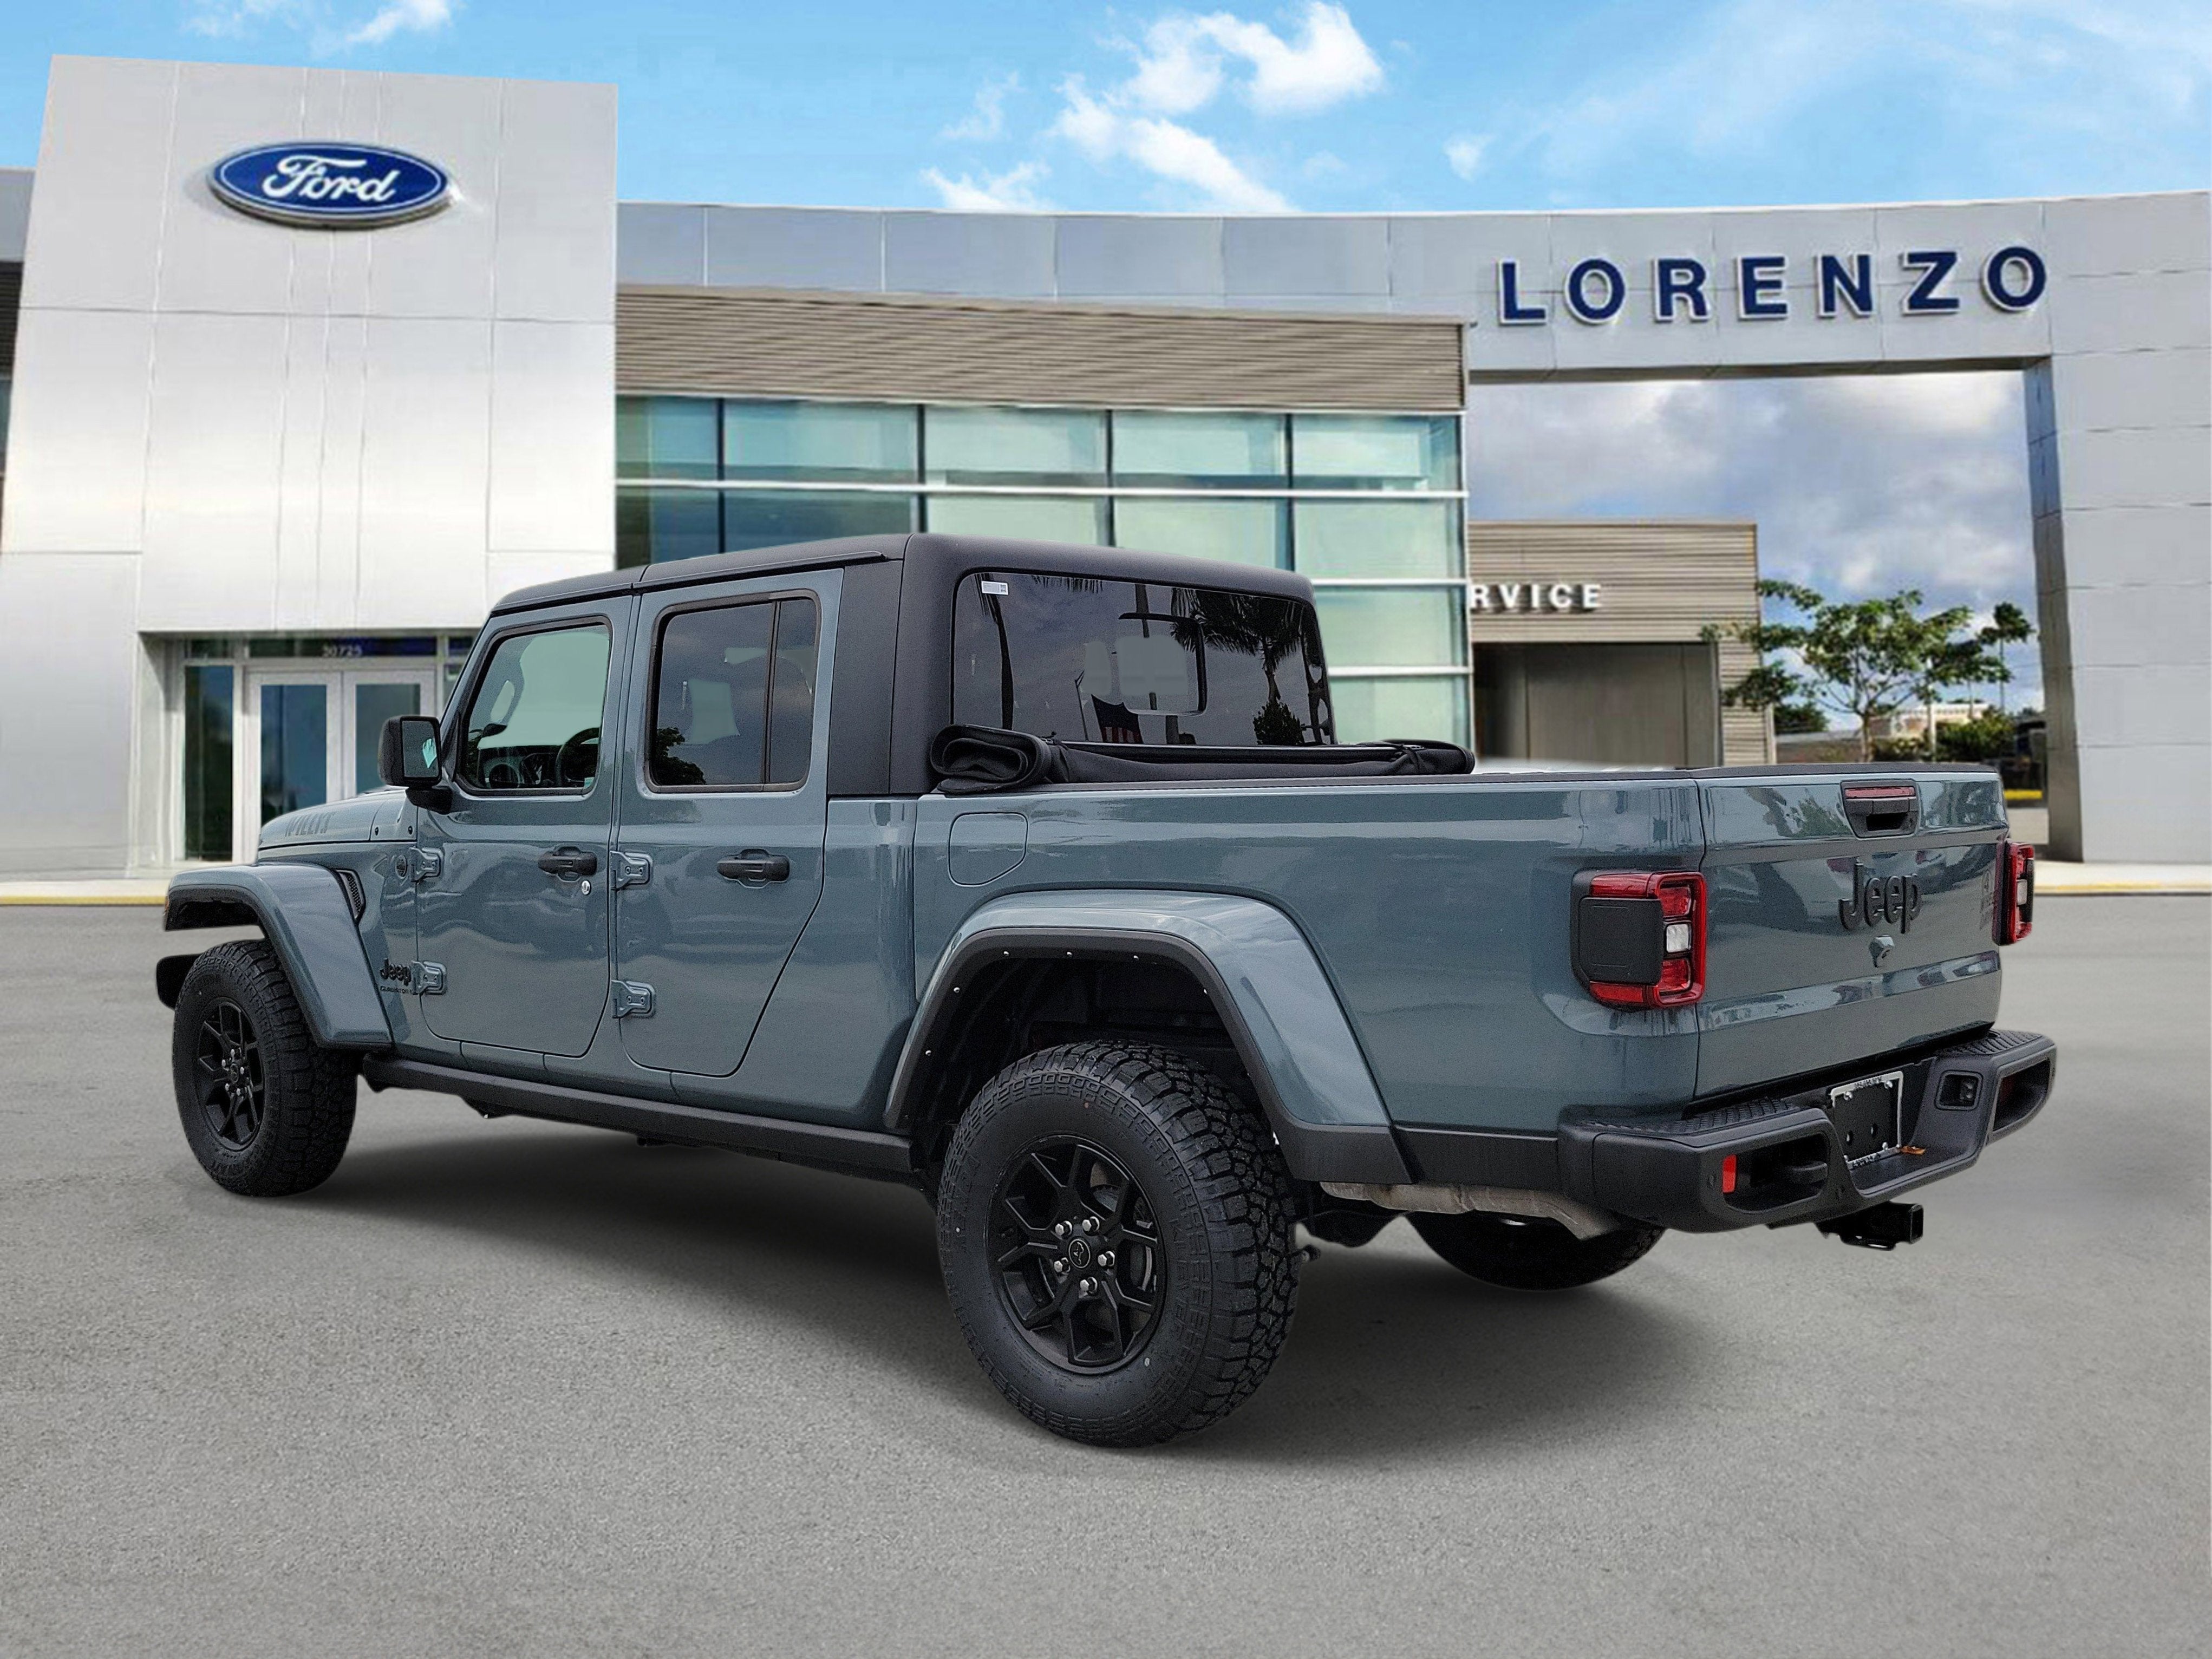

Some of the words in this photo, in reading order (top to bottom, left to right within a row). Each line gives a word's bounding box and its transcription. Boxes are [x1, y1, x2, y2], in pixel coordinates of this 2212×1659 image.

[262, 154, 400, 202] Ford
[1499, 246, 2047, 324] LORENZO
[1838, 861, 1922, 934] Jeep
[380, 958, 412, 986] Jeep
